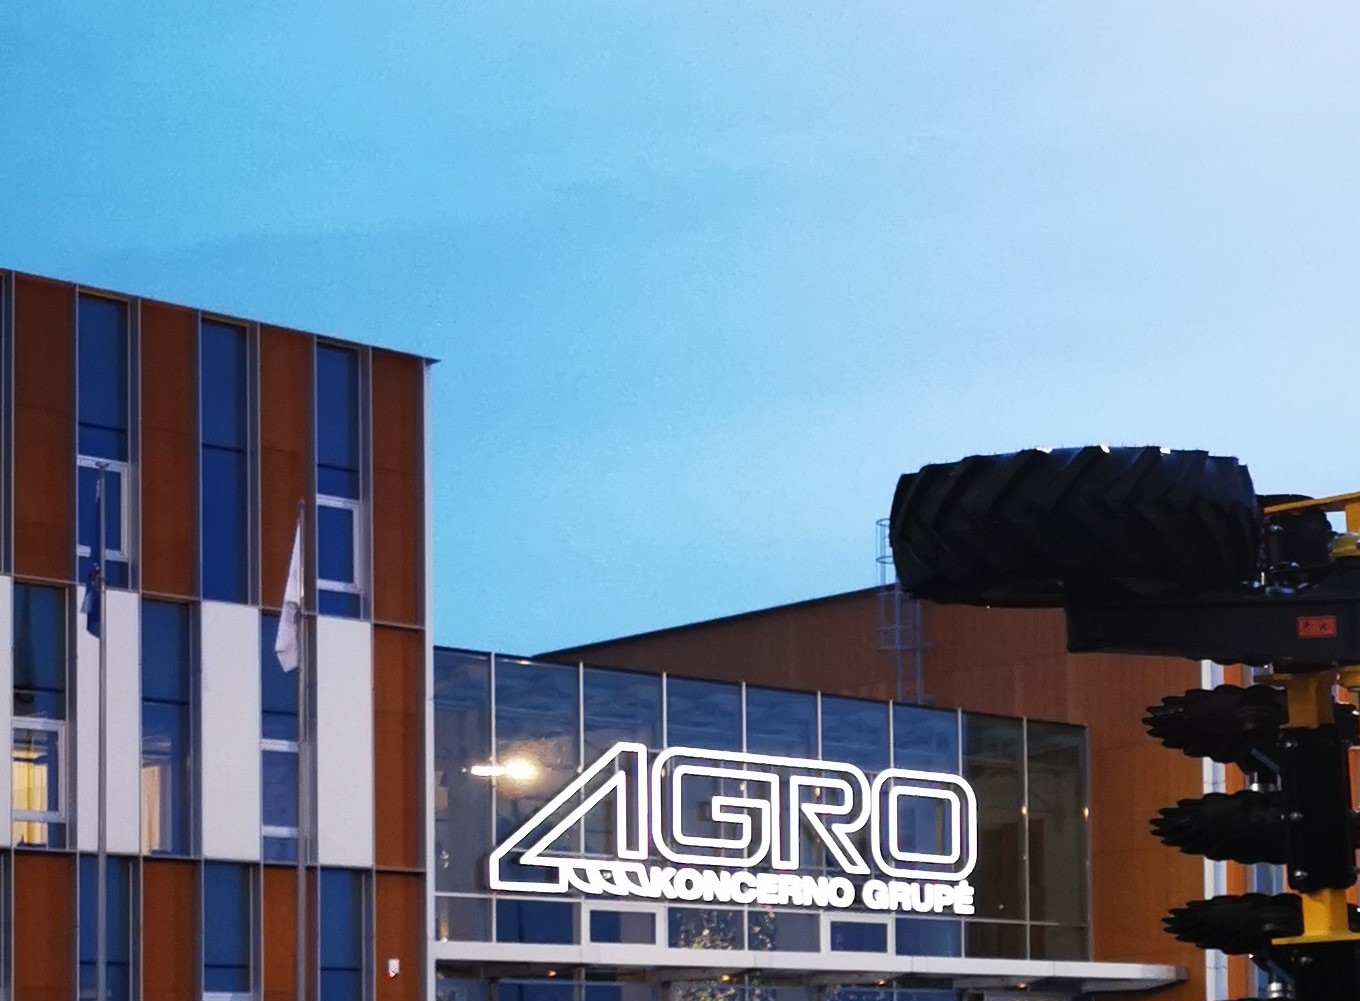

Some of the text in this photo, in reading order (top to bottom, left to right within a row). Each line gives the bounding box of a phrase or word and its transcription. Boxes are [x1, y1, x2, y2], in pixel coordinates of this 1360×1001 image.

[489, 741, 977, 892] AGRO
[649, 866, 975, 915] KONCERNO GRUPĖ
